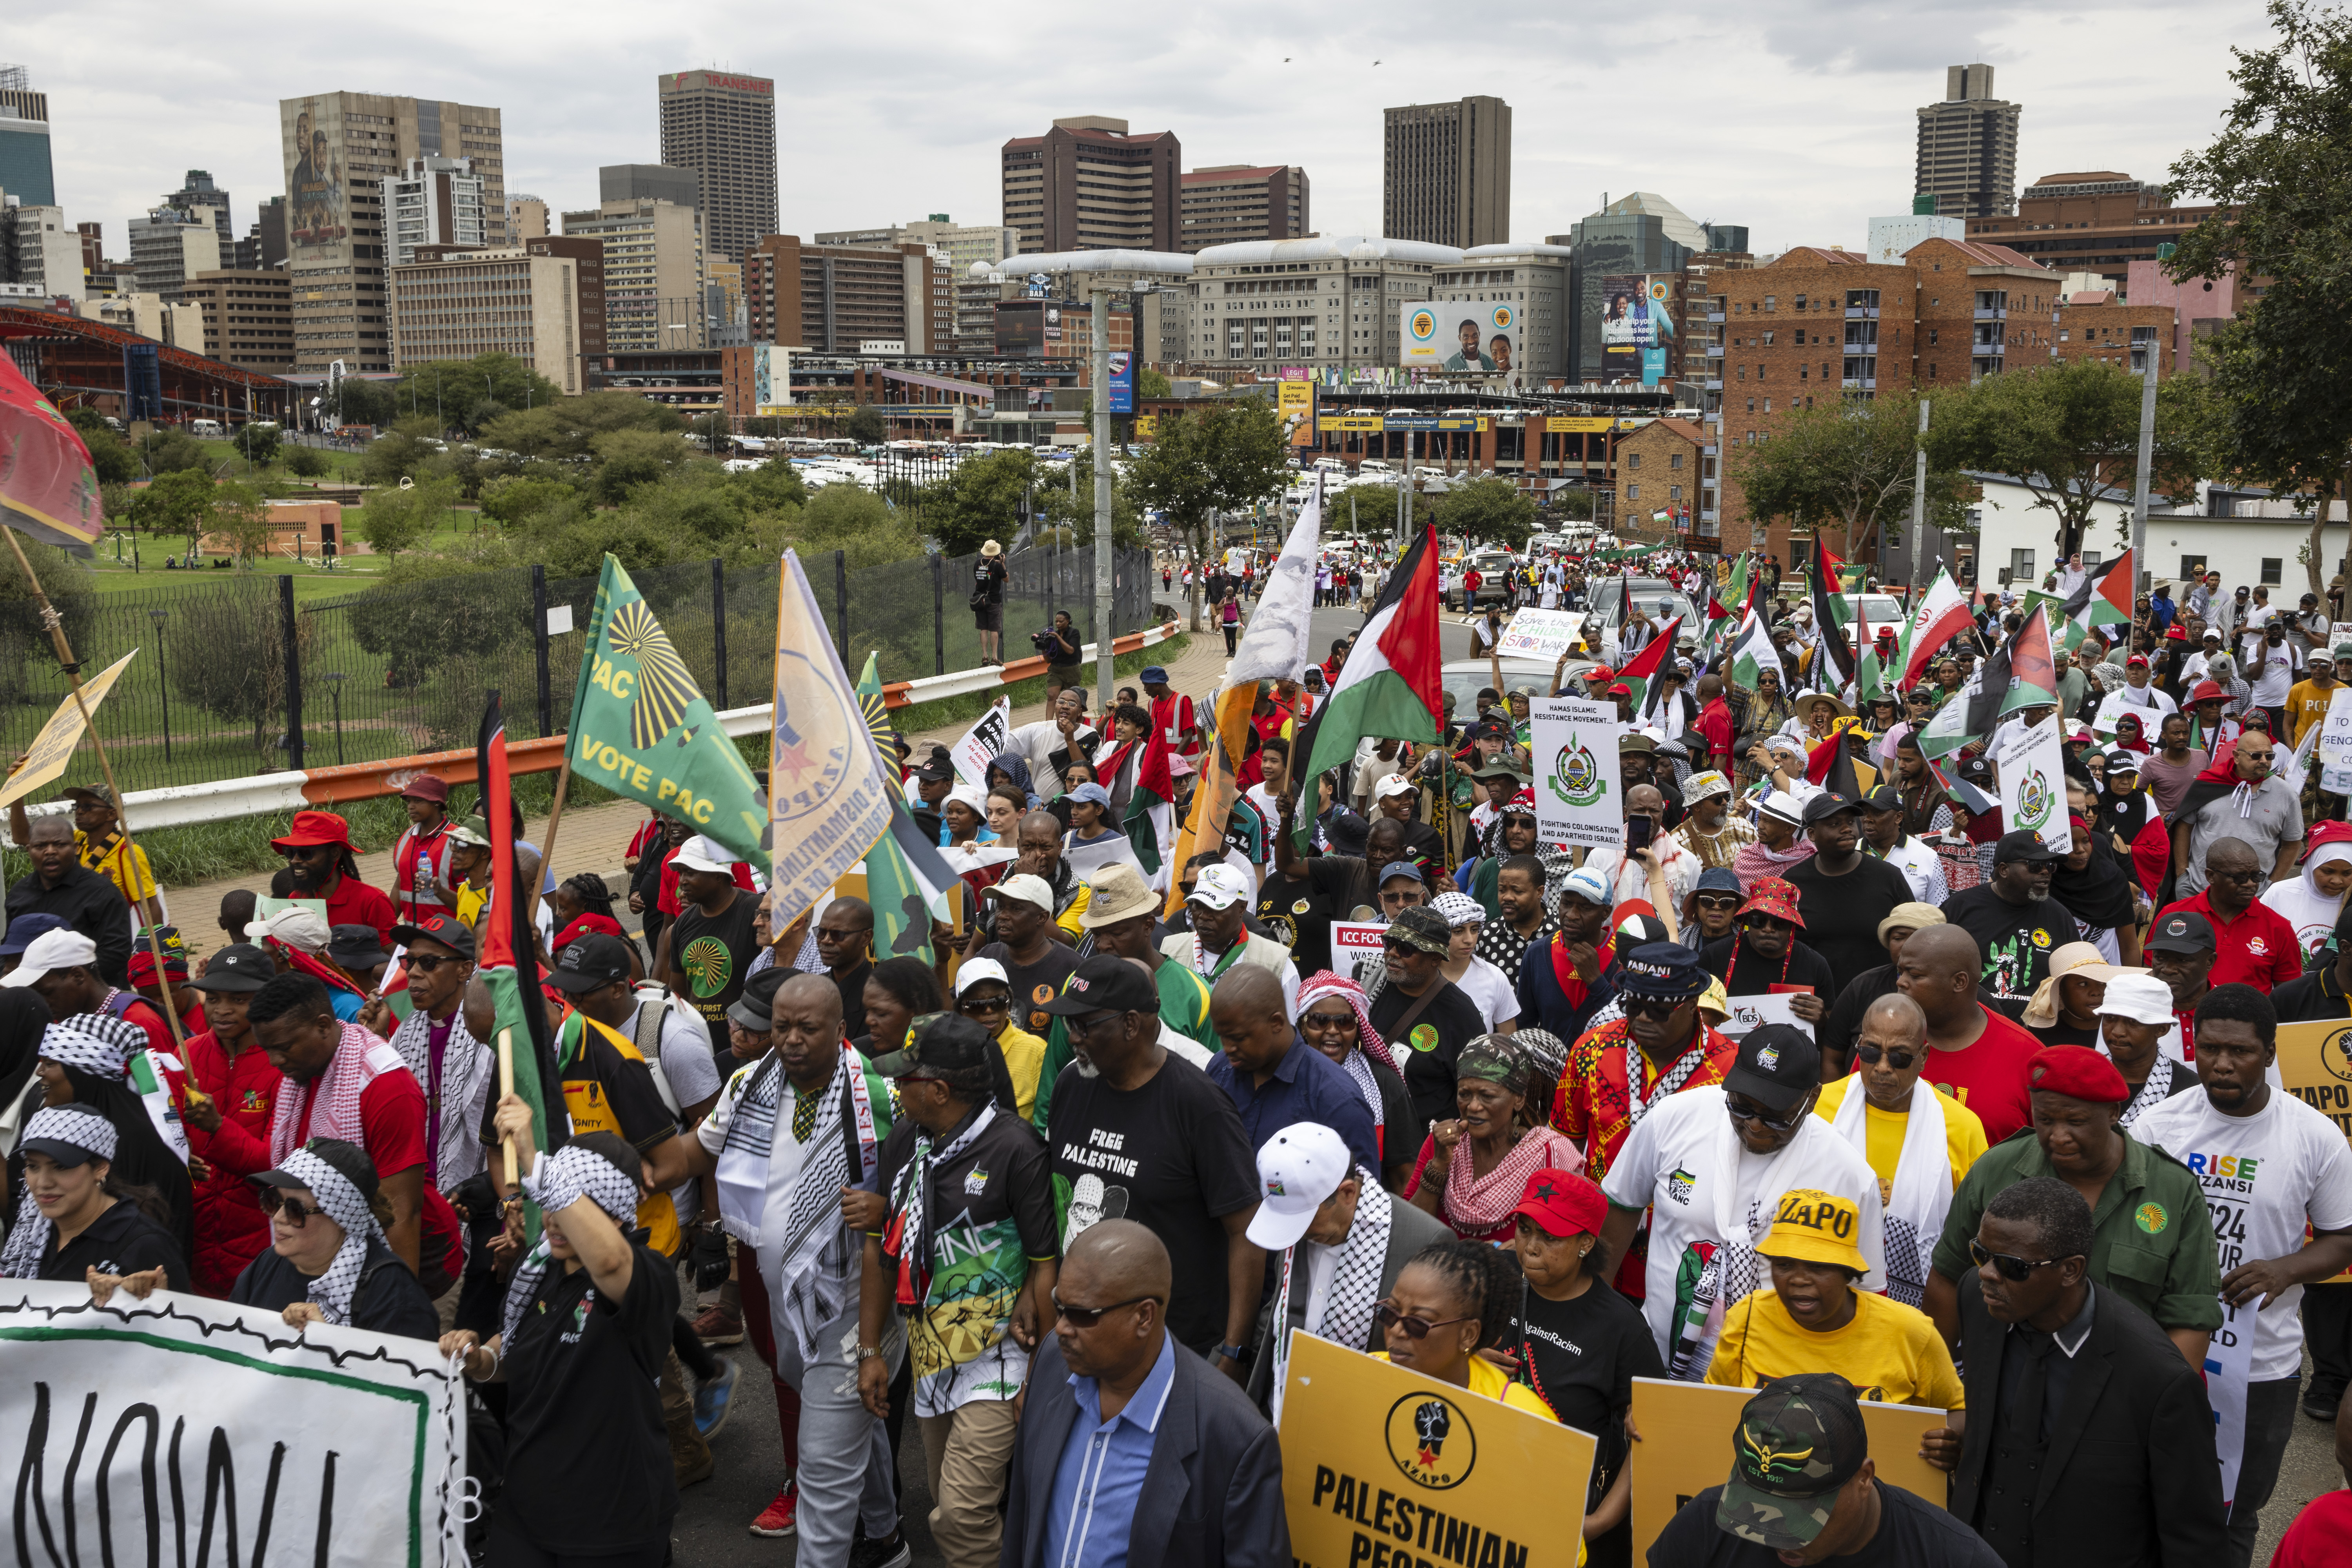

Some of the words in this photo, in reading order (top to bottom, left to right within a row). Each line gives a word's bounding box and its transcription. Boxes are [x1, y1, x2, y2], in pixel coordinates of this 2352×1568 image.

[705, 74, 773, 93] TRANSNET
[1608, 318, 1622, 326] Let's
[1625, 318, 1639, 327] help
[1640, 318, 1655, 327] your
[1608, 326, 1637, 334] business
[1637, 325, 1655, 334] keep
[1551, 617, 1572, 630] the
[1518, 624, 1575, 641] CHILDREN
[1541, 641, 1565, 654] WAR
[1534, 713, 1572, 721] RESISTANCE
[1573, 715, 1613, 724] MOVEMENT...
[2011, 739, 2026, 754] HAMAS
[2026, 728, 2044, 743] ISLAMIC
[967, 744, 976, 753] AN
[971, 738, 979, 746] NO
[978, 746, 993, 761] SPORT
[2001, 747, 2027, 769] RESISTANCE
[2113, 757, 2134, 766] PALESTINE
[968, 756, 987, 776] SOCIETY
[581, 733, 653, 792] VOTE
[656, 777, 715, 824] PAC
[1541, 820, 1571, 829] FIGHTING
[1572, 823, 1619, 834] COLONISATION
[1556, 831, 1593, 841] APARTHEID
[1594, 835, 1620, 844] ISRAEL!
[1342, 931, 1359, 943] ICC
[2298, 931, 2313, 942] FREE
[686, 966, 704, 977] PAC
[1627, 960, 1671, 975] FABIANI
[1990, 992, 2033, 1002] PALESTINE
[702, 1004, 722, 1013] FIRST
[1742, 1014, 1758, 1023] BDS
[1412, 1032, 1423, 1041] PAC
[2283, 1084, 2350, 1110] ZAPO
[850, 1060, 877, 1169] PALESTINE
[572, 1118, 603, 1128] IGNITY
[1089, 1128, 1125, 1151] FREE
[1061, 1143, 1138, 1178] PALESTINE
[2187, 1152, 2258, 1181] RISE
[2197, 1174, 2253, 1194] ZANSI
[1672, 1193, 1690, 1206] ANC
[2136, 1214, 2151, 1223] PAC
[1760, 1445, 1771, 1473] ANC
[1401, 1458, 1452, 1485] AZAPO
[1748, 1465, 1764, 1478] EST.
[1766, 1474, 1784, 1484] 1912
[1312, 1463, 1529, 1568] PALESTINIAN
